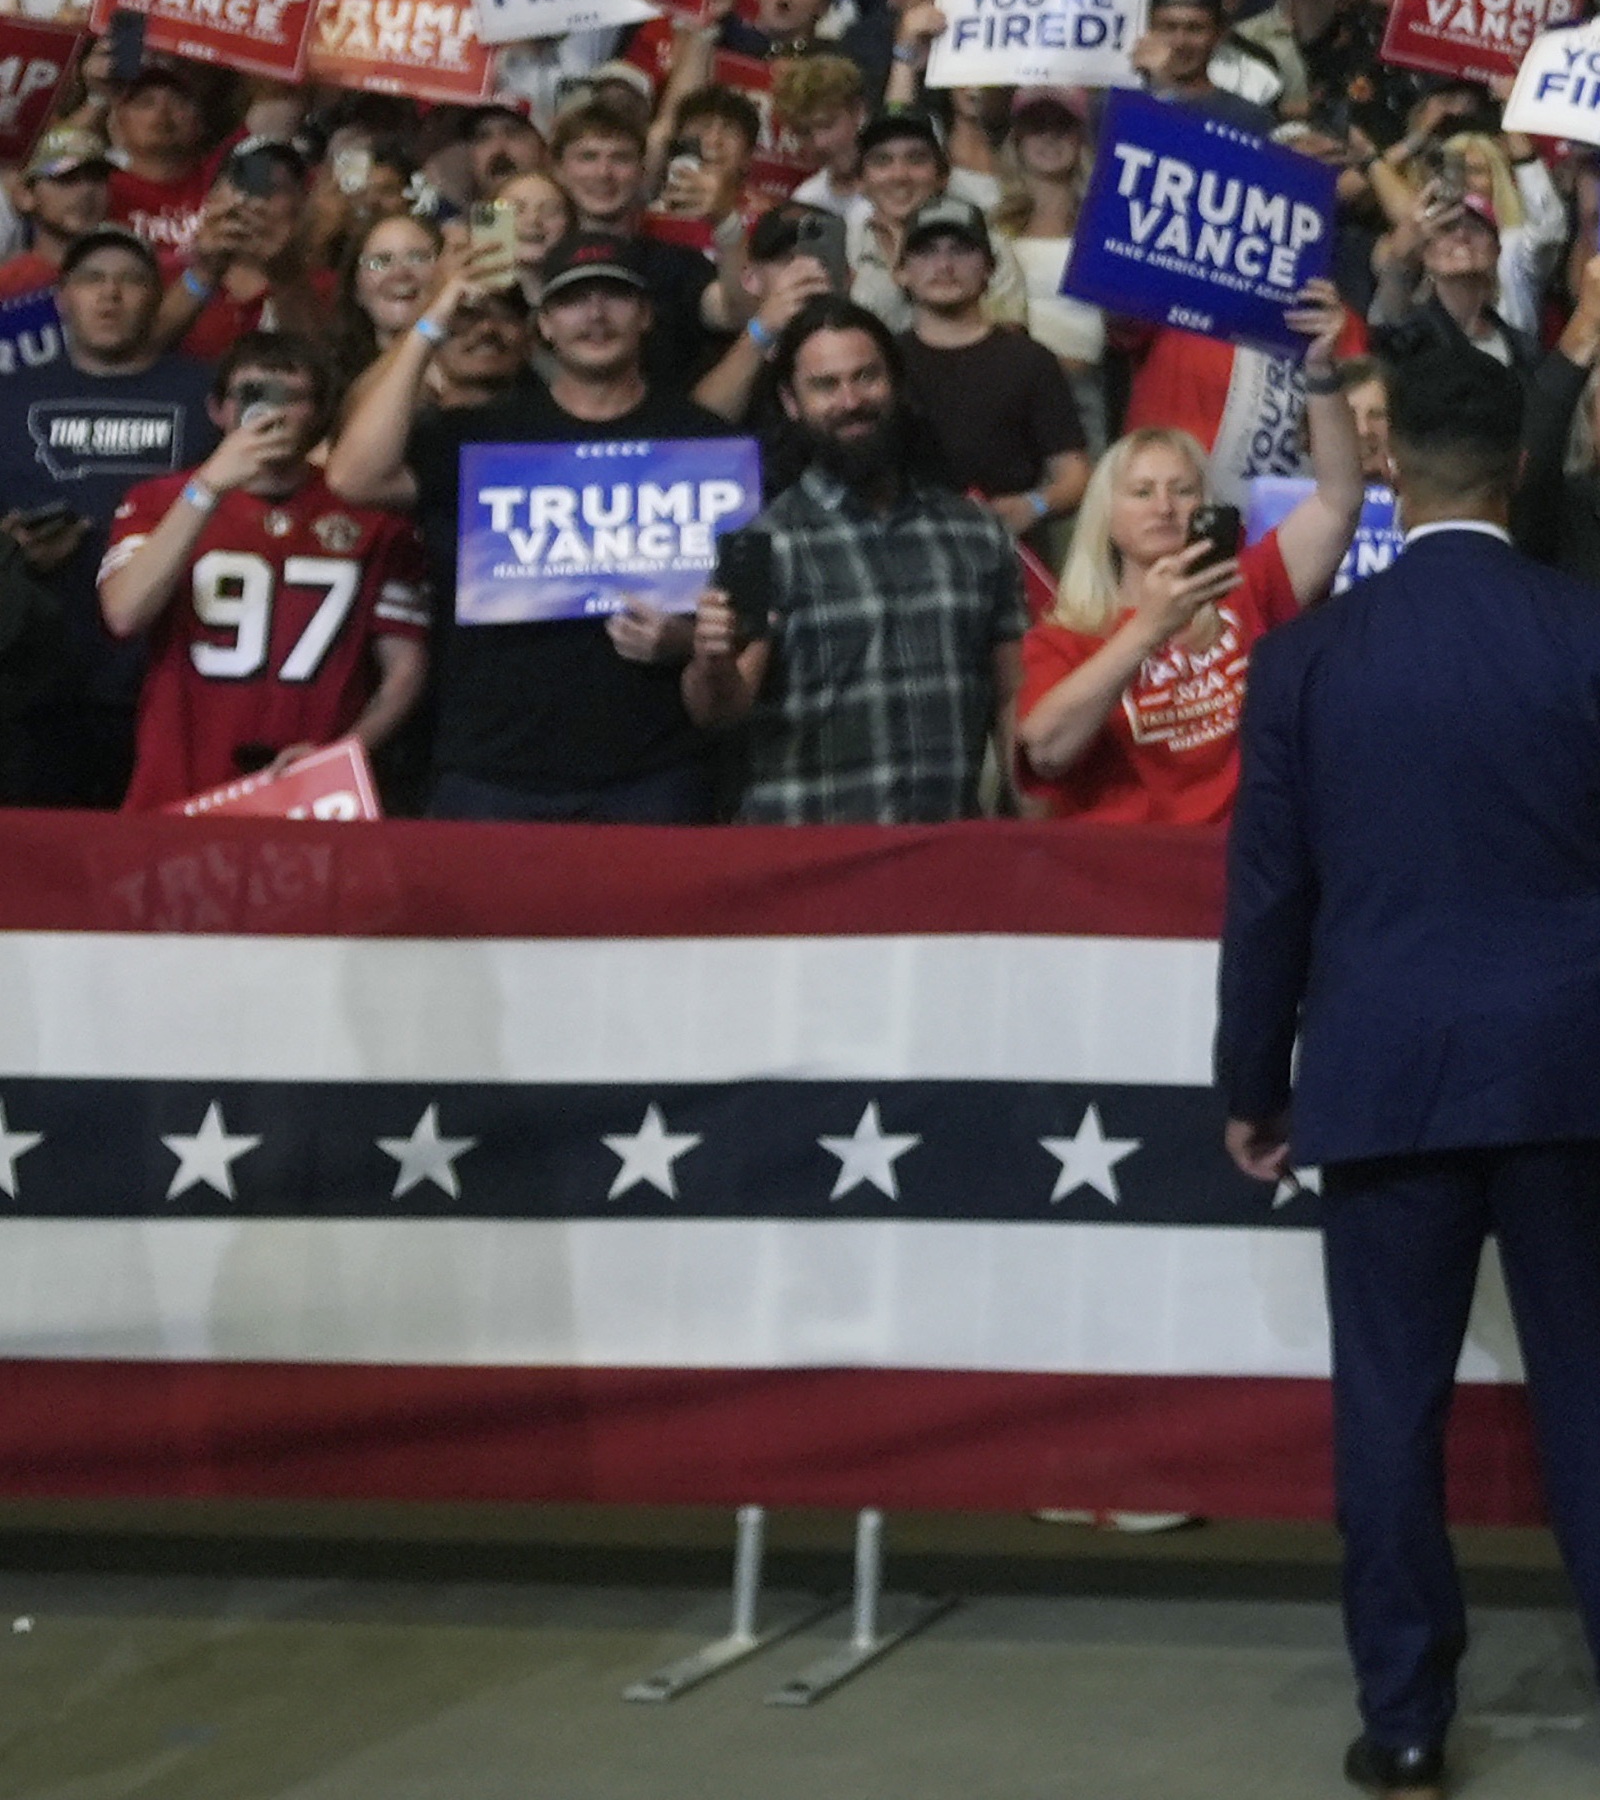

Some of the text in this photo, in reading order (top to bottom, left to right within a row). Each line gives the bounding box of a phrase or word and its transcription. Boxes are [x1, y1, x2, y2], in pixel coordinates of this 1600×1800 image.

[952, 13, 1126, 52] FIRED!
[1113, 142, 1324, 250] TRUMP
[1128, 199, 1299, 289] VANCE
[478, 479, 744, 534] TRUMP
[507, 520, 716, 565] VANCE
[190, 549, 362, 682] 97
